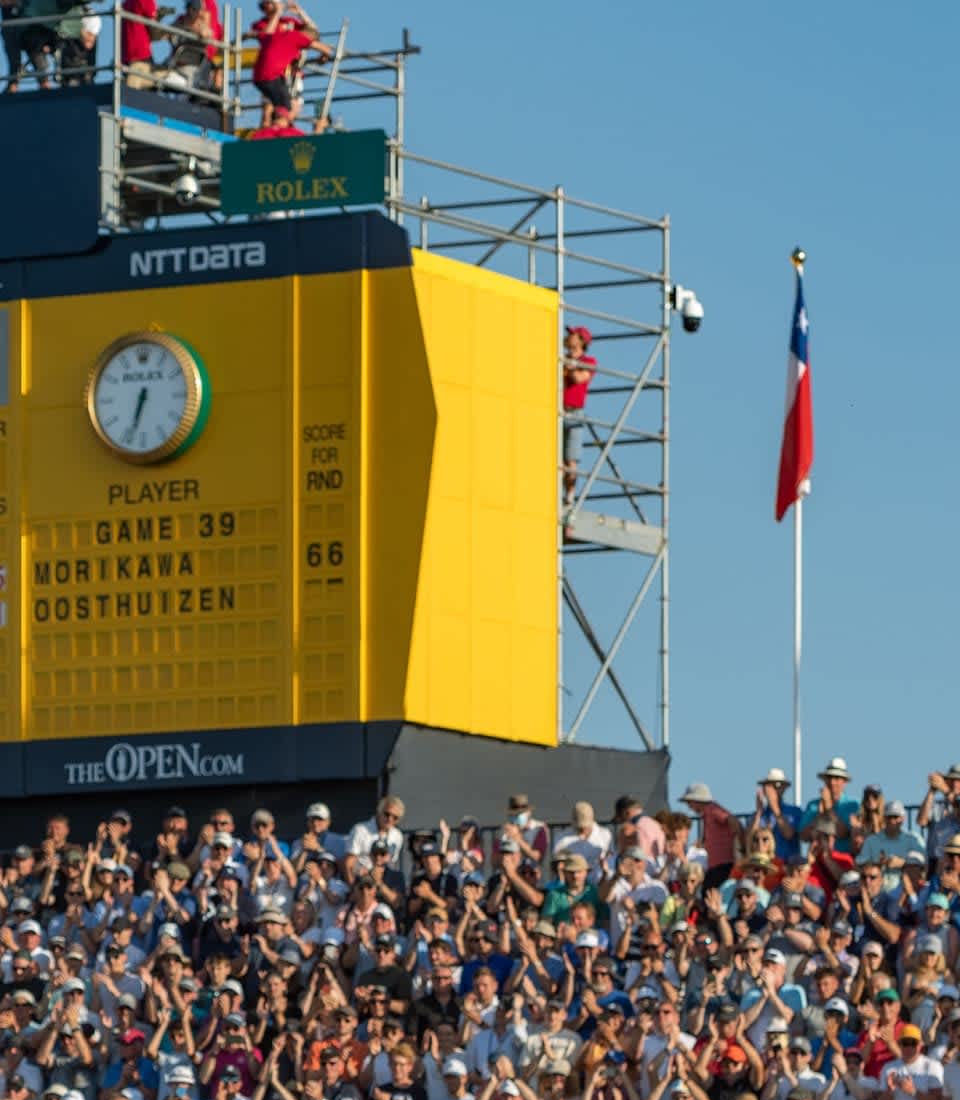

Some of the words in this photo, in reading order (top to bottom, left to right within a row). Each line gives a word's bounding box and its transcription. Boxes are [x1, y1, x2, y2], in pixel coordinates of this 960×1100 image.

[257, 177, 349, 204] ROLEX
[303, 423, 345, 442] SCORE
[311, 447, 338, 464] FOR
[108, 479, 200, 505] PLAYER
[306, 469, 344, 491] RND
[96, 514, 174, 545] GAME
[199, 511, 236, 538] 39
[306, 541, 344, 568] 66
[34, 551, 194, 586] MORIKAWA
[34, 587, 236, 624] OOSTHUIZEN
